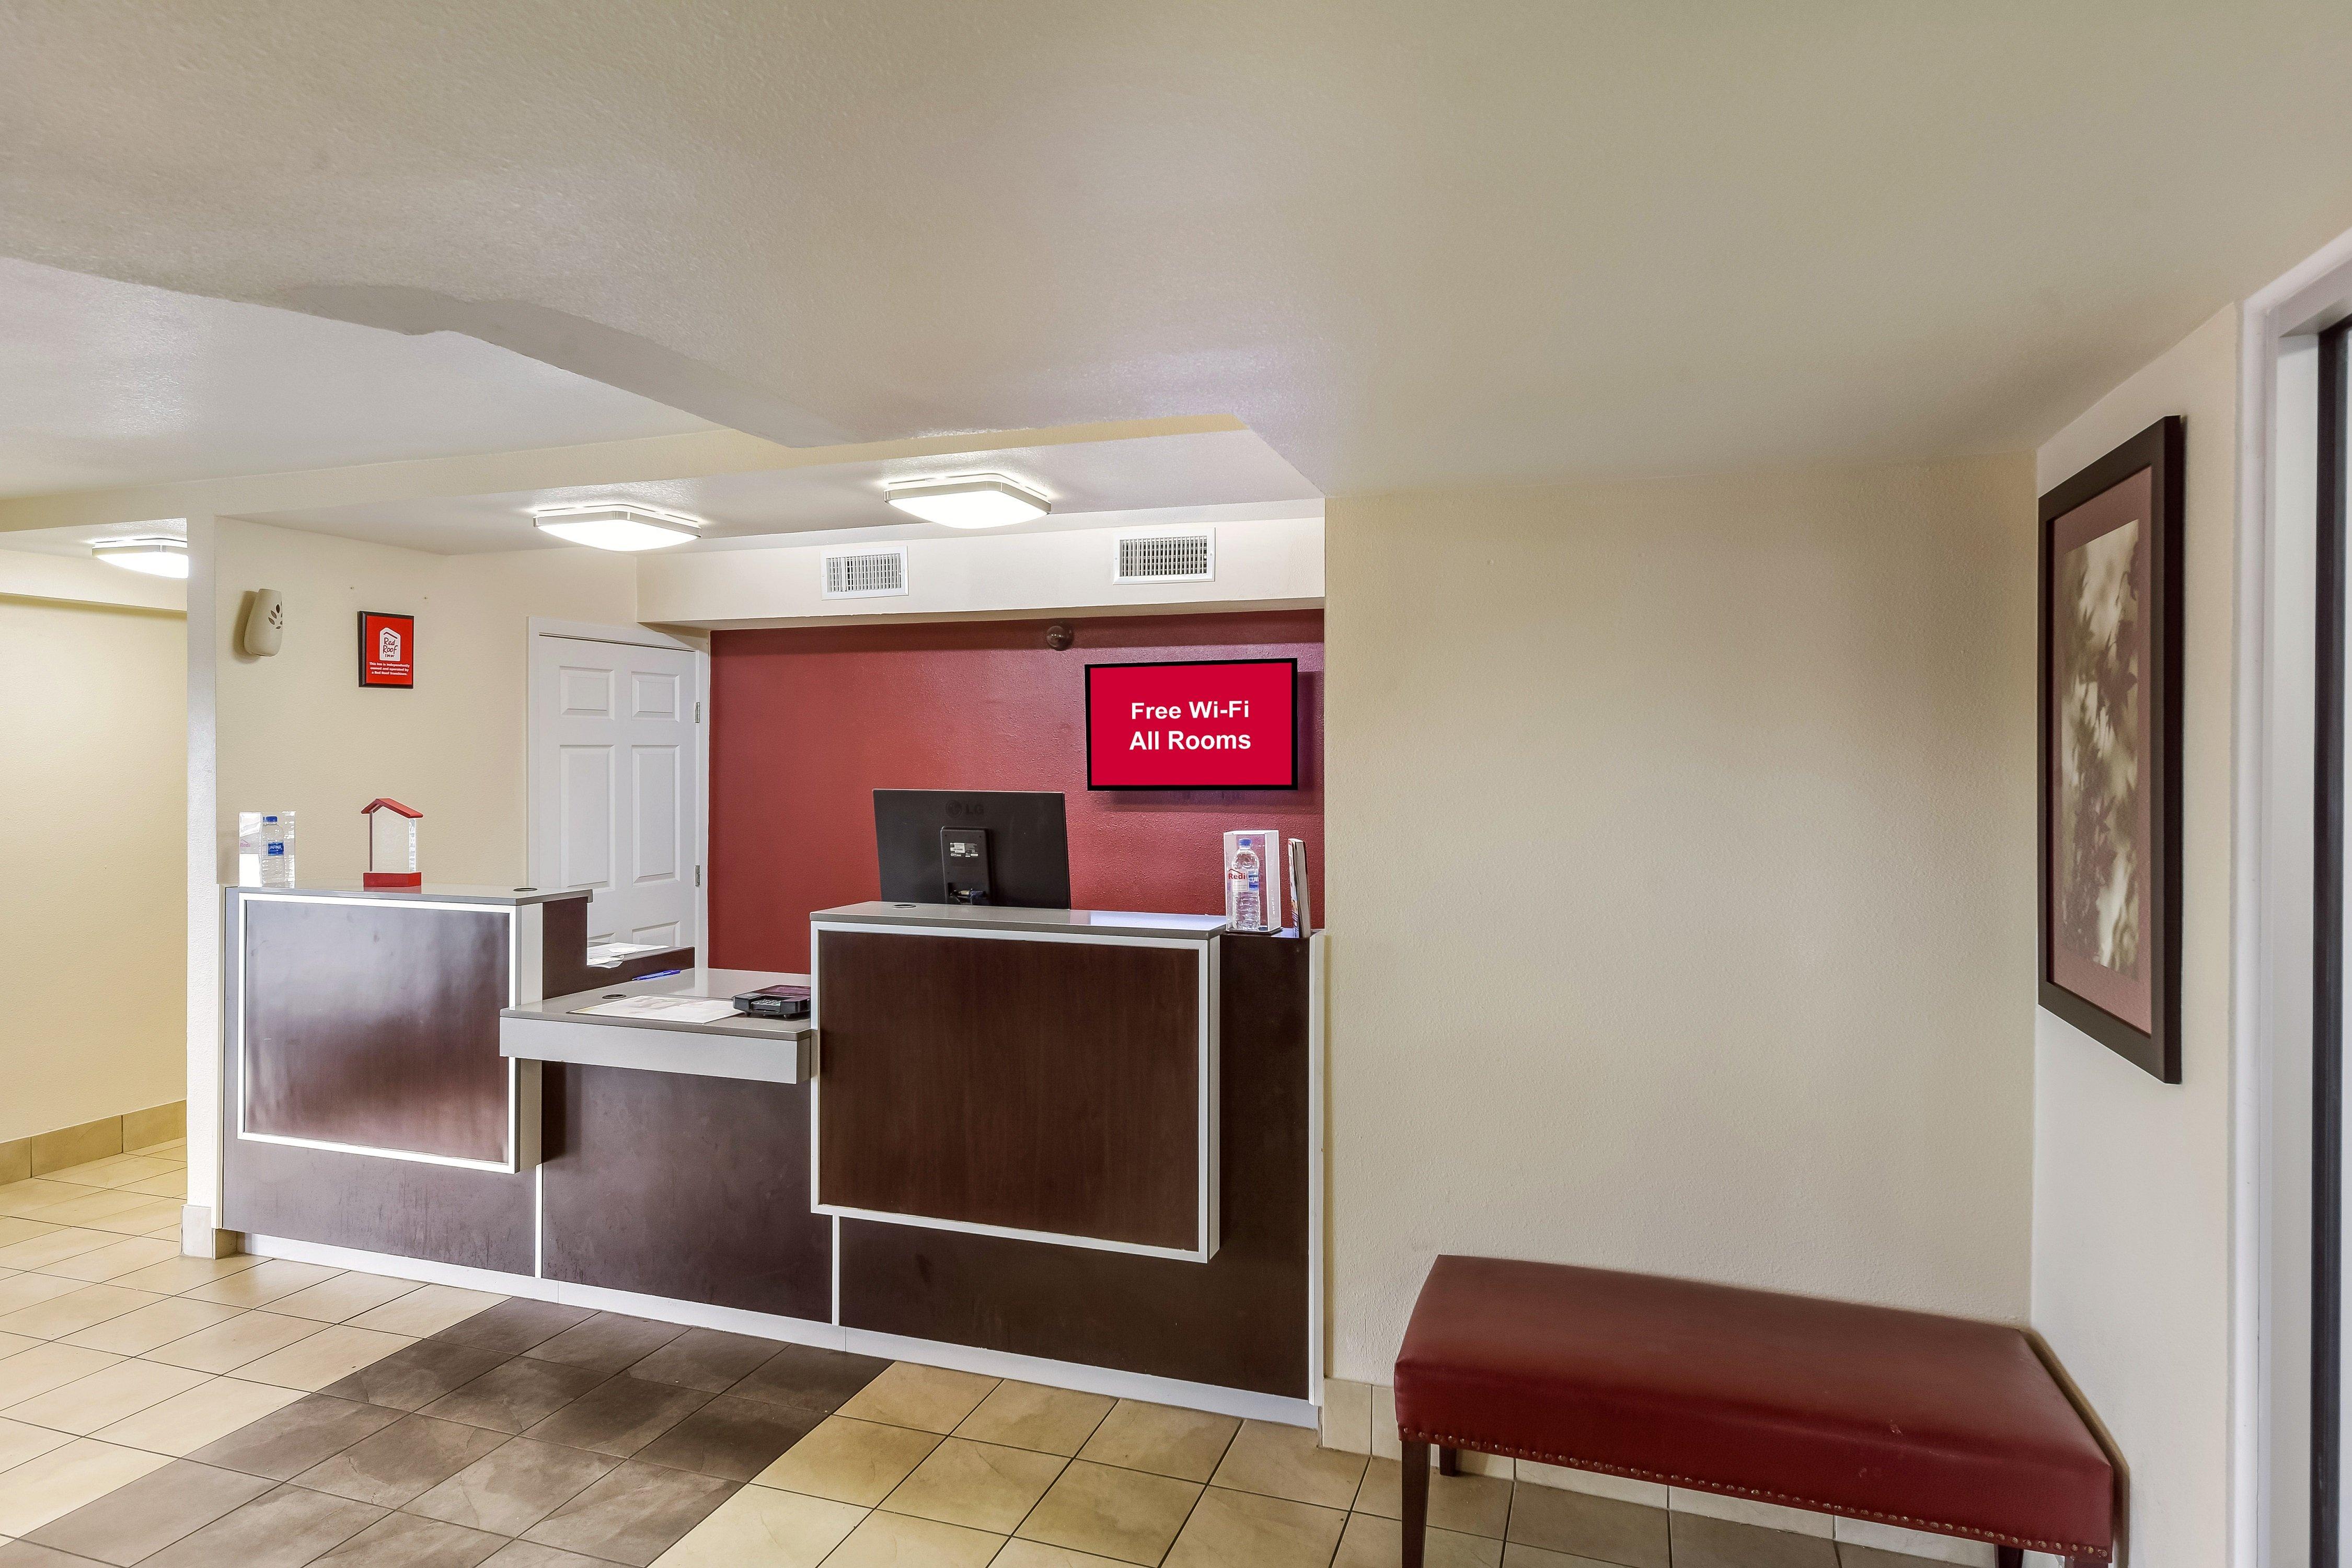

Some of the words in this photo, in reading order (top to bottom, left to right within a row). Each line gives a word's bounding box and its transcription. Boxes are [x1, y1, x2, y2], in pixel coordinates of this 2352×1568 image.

[384, 637, 396, 645] Red
[383, 645, 398, 654] Roof
[1131, 702, 1182, 720] Free
[1189, 700, 1249, 719] Wi-Fi
[1129, 731, 1159, 751] All
[1168, 731, 1251, 751] Rooms
[965, 803, 984, 815] LG
